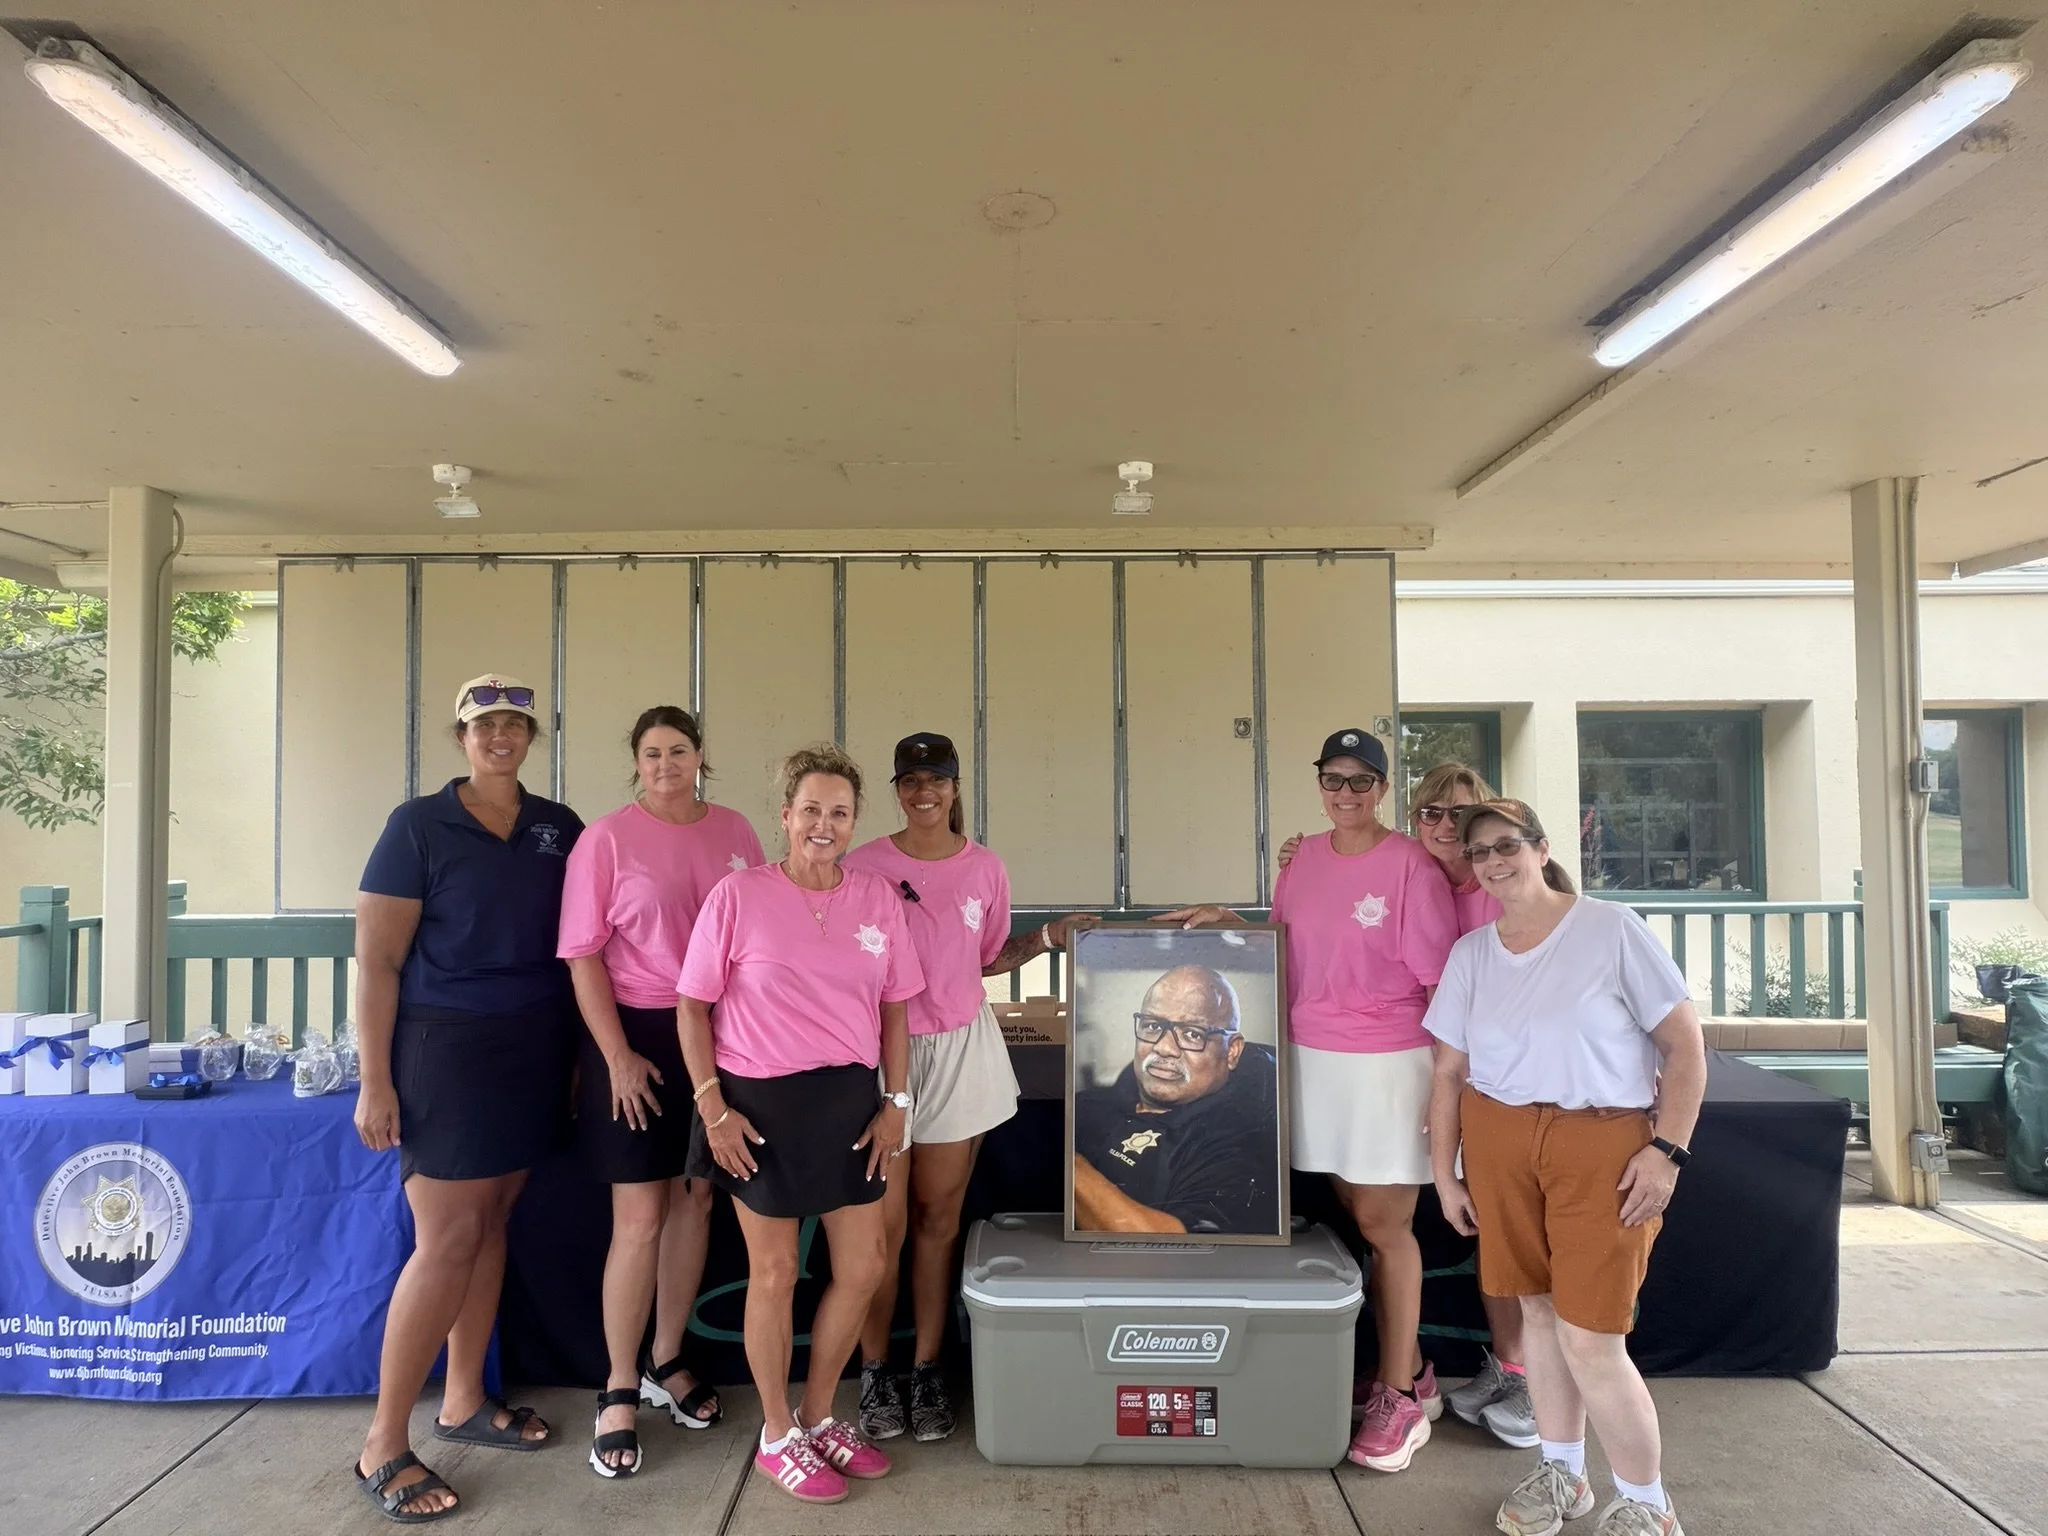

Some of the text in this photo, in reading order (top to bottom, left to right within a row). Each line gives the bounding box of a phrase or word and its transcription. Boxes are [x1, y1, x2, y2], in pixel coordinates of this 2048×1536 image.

[1019, 1026, 1036, 1034] you,
[1026, 1034, 1053, 1042] inside.
[42, 1185, 60, 1241] Detective
[58, 1163, 80, 1186] John
[82, 1149, 118, 1165] Brown
[122, 1147, 169, 1180] Memorial
[165, 1175, 185, 1241] Foundation
[24, 1312, 54, 1337] John
[58, 1315, 111, 1337] Brown
[114, 1314, 186, 1340] Memorial
[191, 1311, 287, 1337] Foundation
[1122, 1330, 1199, 1351] Coleman
[50, 1346, 94, 1363] Honoring
[131, 1346, 206, 1365] Strengthening
[208, 1342, 269, 1359] Community.
[1147, 1393, 1167, 1410] 120
[1173, 1393, 1182, 1410] 5
